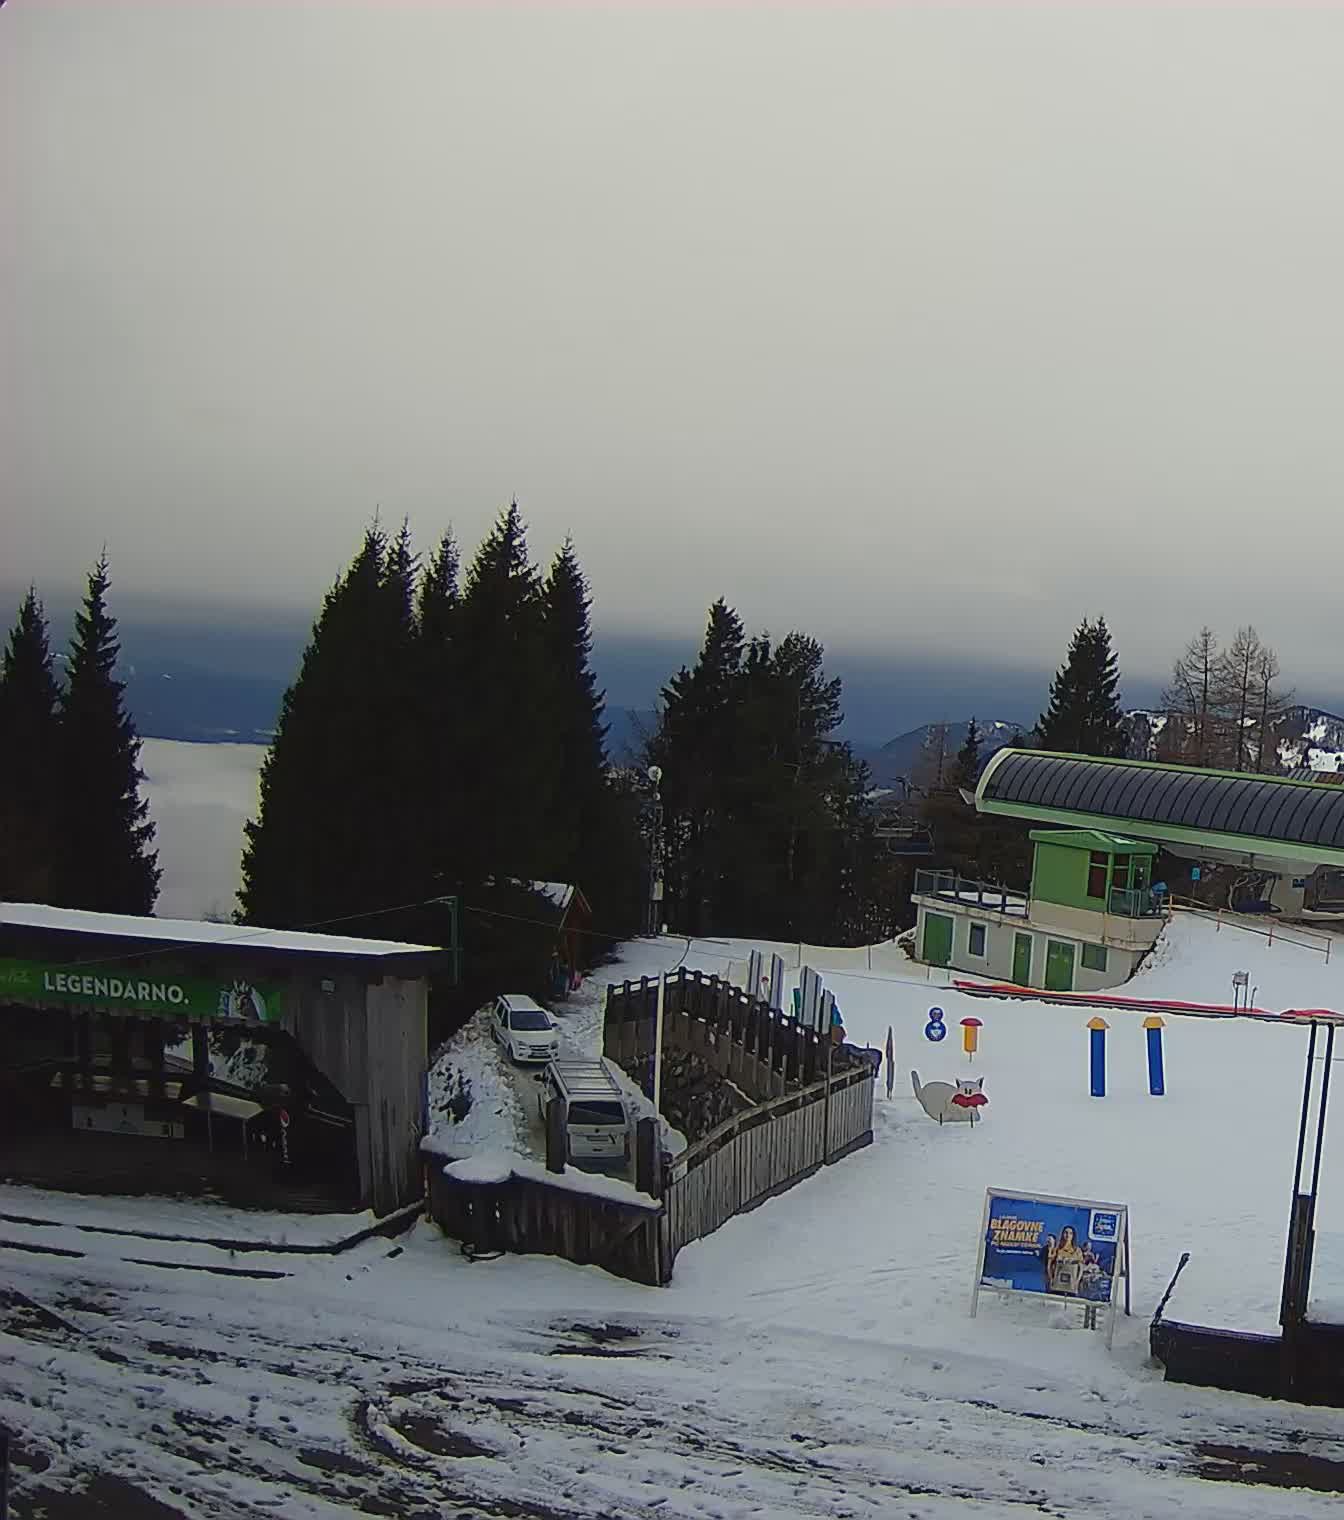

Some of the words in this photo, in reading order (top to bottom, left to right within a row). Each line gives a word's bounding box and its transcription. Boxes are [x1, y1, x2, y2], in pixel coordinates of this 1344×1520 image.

[43, 971, 190, 1005] LEGENDARNO.
[991, 1218, 1045, 1233] BLAGOVNE
[992, 1230, 1039, 1243] ZNAMKE
